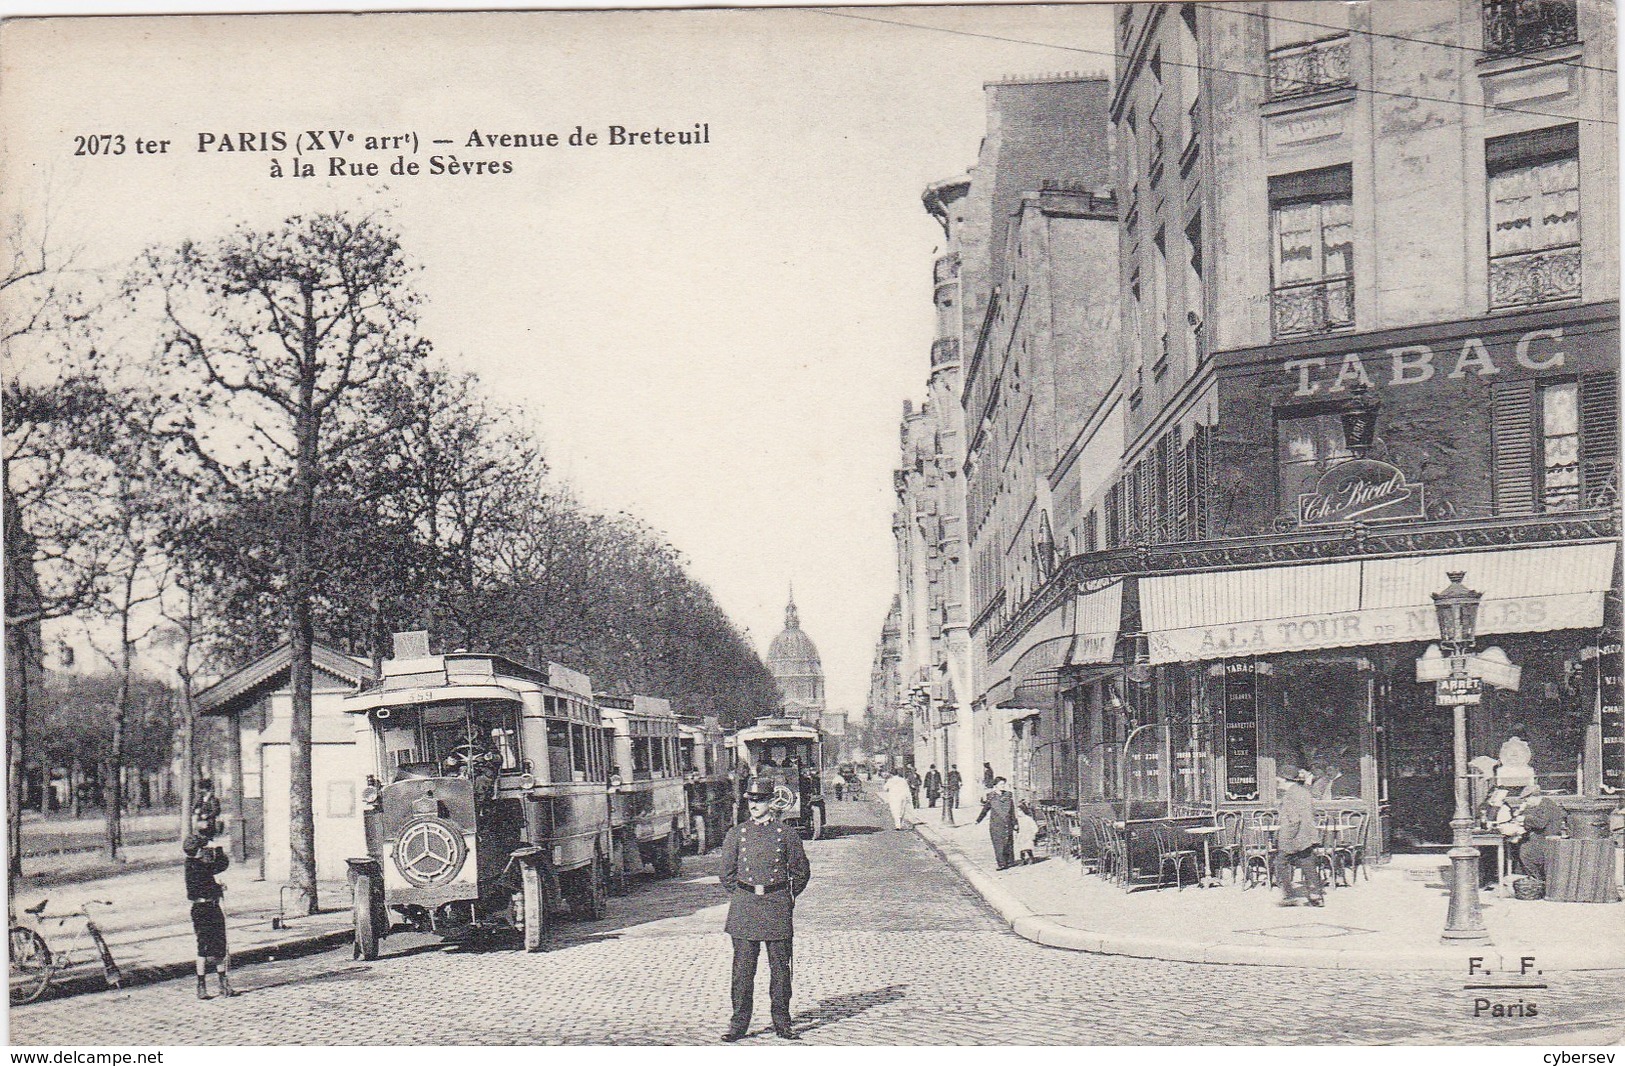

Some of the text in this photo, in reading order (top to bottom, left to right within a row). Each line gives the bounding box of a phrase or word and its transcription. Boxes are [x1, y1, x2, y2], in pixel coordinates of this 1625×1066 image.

[1284, 328, 1566, 397] TABAC
[1302, 494, 1336, 520] Ch.
[1276, 615, 1364, 644] TOUR
[1374, 624, 1396, 635] DE
[1405, 600, 1547, 632] NLES
[1226, 663, 1255, 674] TABAC
